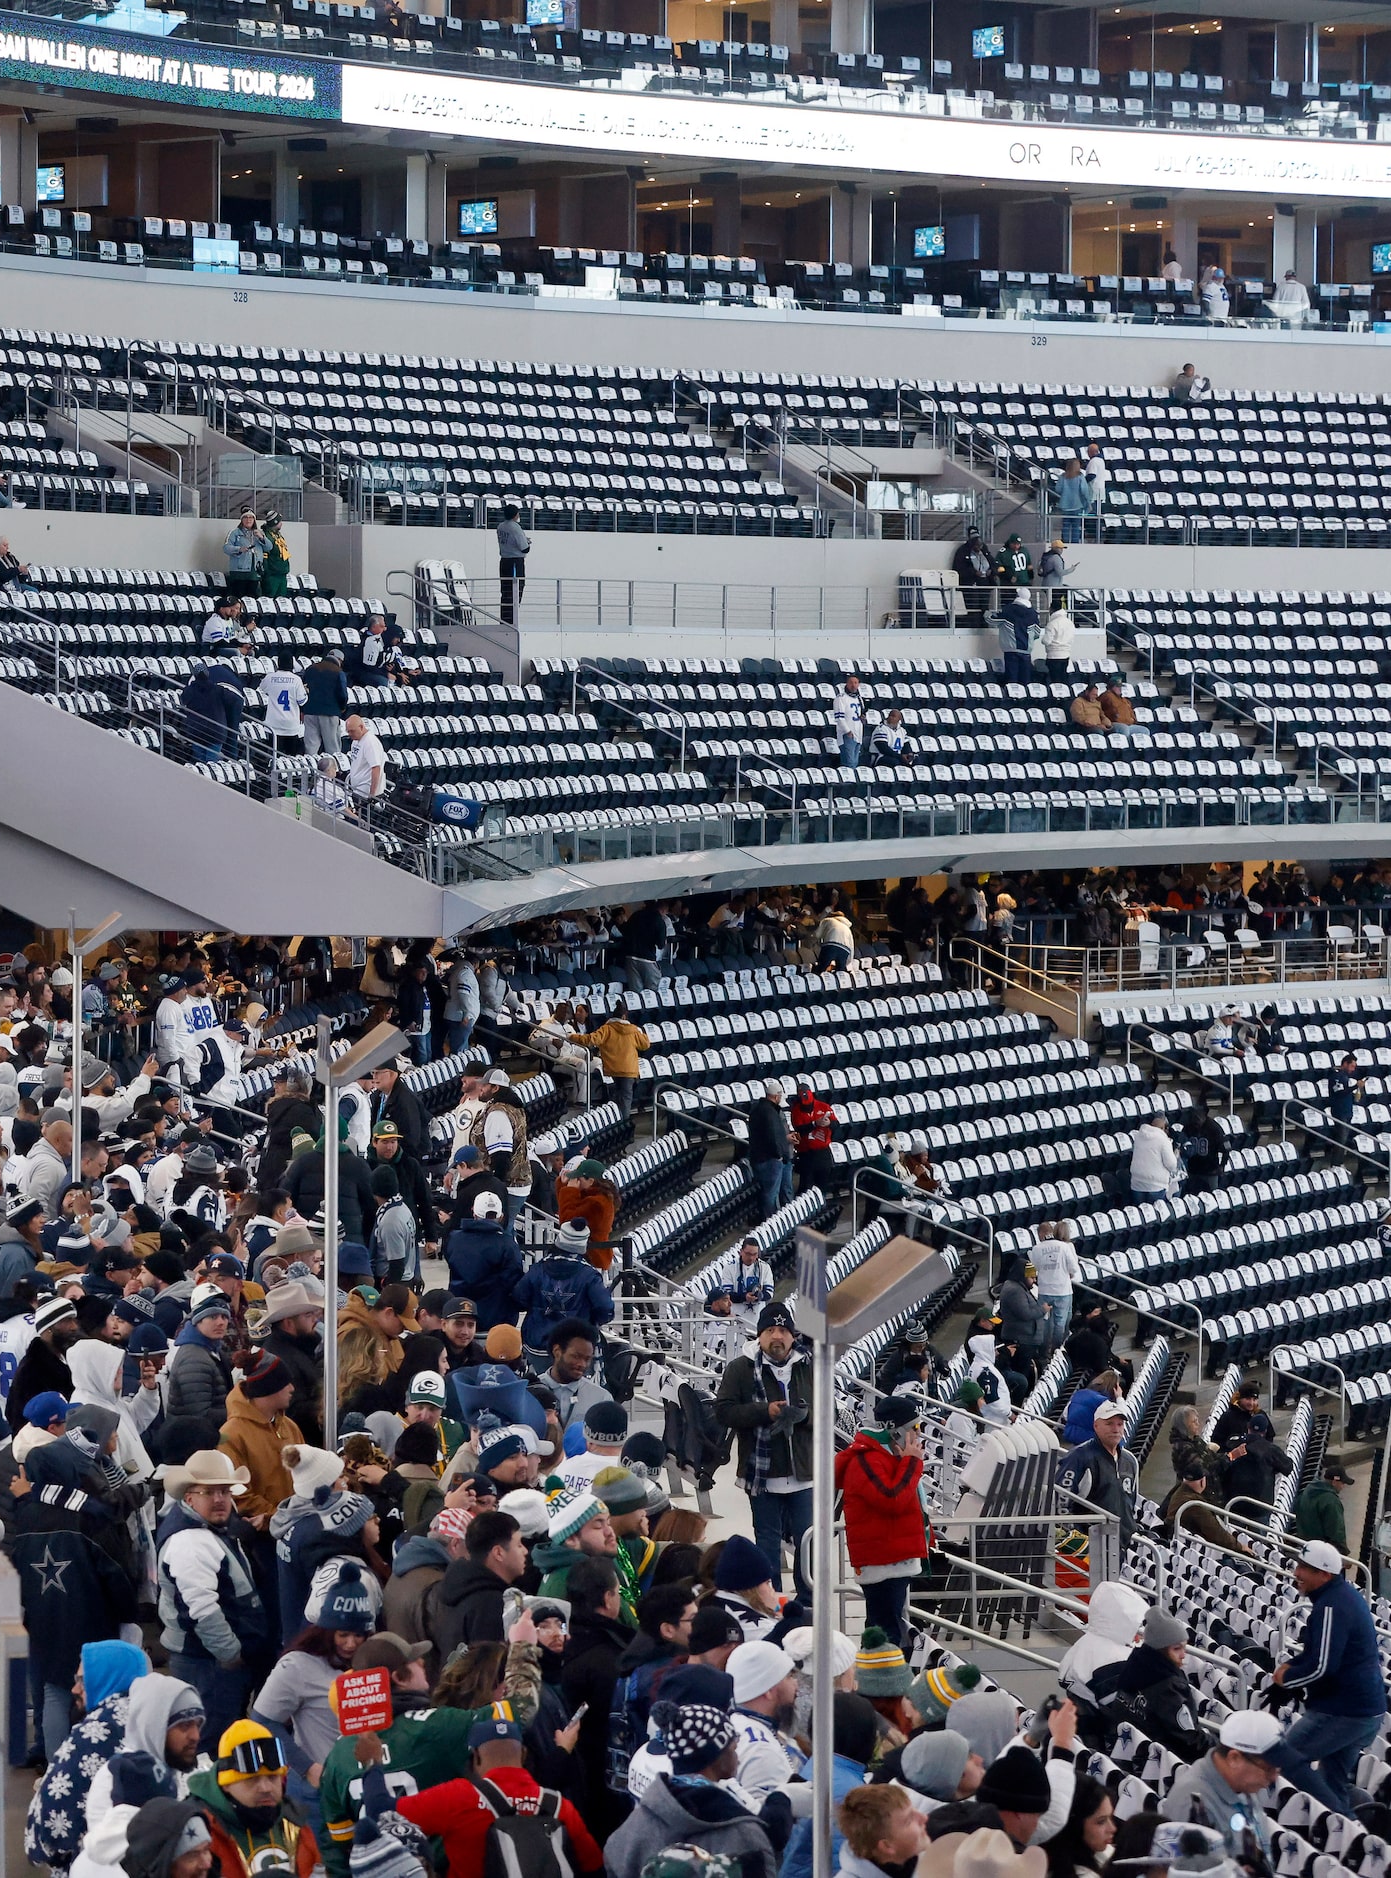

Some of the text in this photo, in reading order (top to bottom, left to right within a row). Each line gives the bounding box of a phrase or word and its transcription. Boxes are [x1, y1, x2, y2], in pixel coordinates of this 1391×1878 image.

[28, 37, 85, 70] WALLEN
[88, 48, 119, 75] ONE
[120, 53, 162, 82] NIGHT
[162, 59, 181, 84] AT
[181, 62, 194, 87] A
[194, 64, 230, 91] TIME
[232, 68, 277, 97] TOUR
[278, 74, 316, 101] 2024
[374, 89, 408, 111] JULY
[470, 100, 534, 126] MORGAN
[538, 107, 596, 133] WALLEN
[601, 114, 635, 135] ONE
[774, 130, 817, 149] TOUR
[1009, 142, 1101, 168] OR RA
[1154, 151, 1194, 172] JULY
[1262, 159, 1334, 182] MORGAN
[1339, 162, 1391, 183] WALLE
[233, 292, 248, 303] 328
[1031, 336, 1047, 346] 329
[1012, 553, 1027, 572] 10
[270, 676, 295, 684] PRESCOTT
[277, 690, 291, 711] 4
[894, 738, 902, 751] 4
[449, 805, 465, 815] FOX
[191, 1005, 214, 1031] 88
[343, 1673, 382, 1688] ASK ME
[346, 1685, 380, 1698] ABOUT
[341, 1692, 386, 1710] PRICING!
[346, 1721, 364, 1730] CASH
